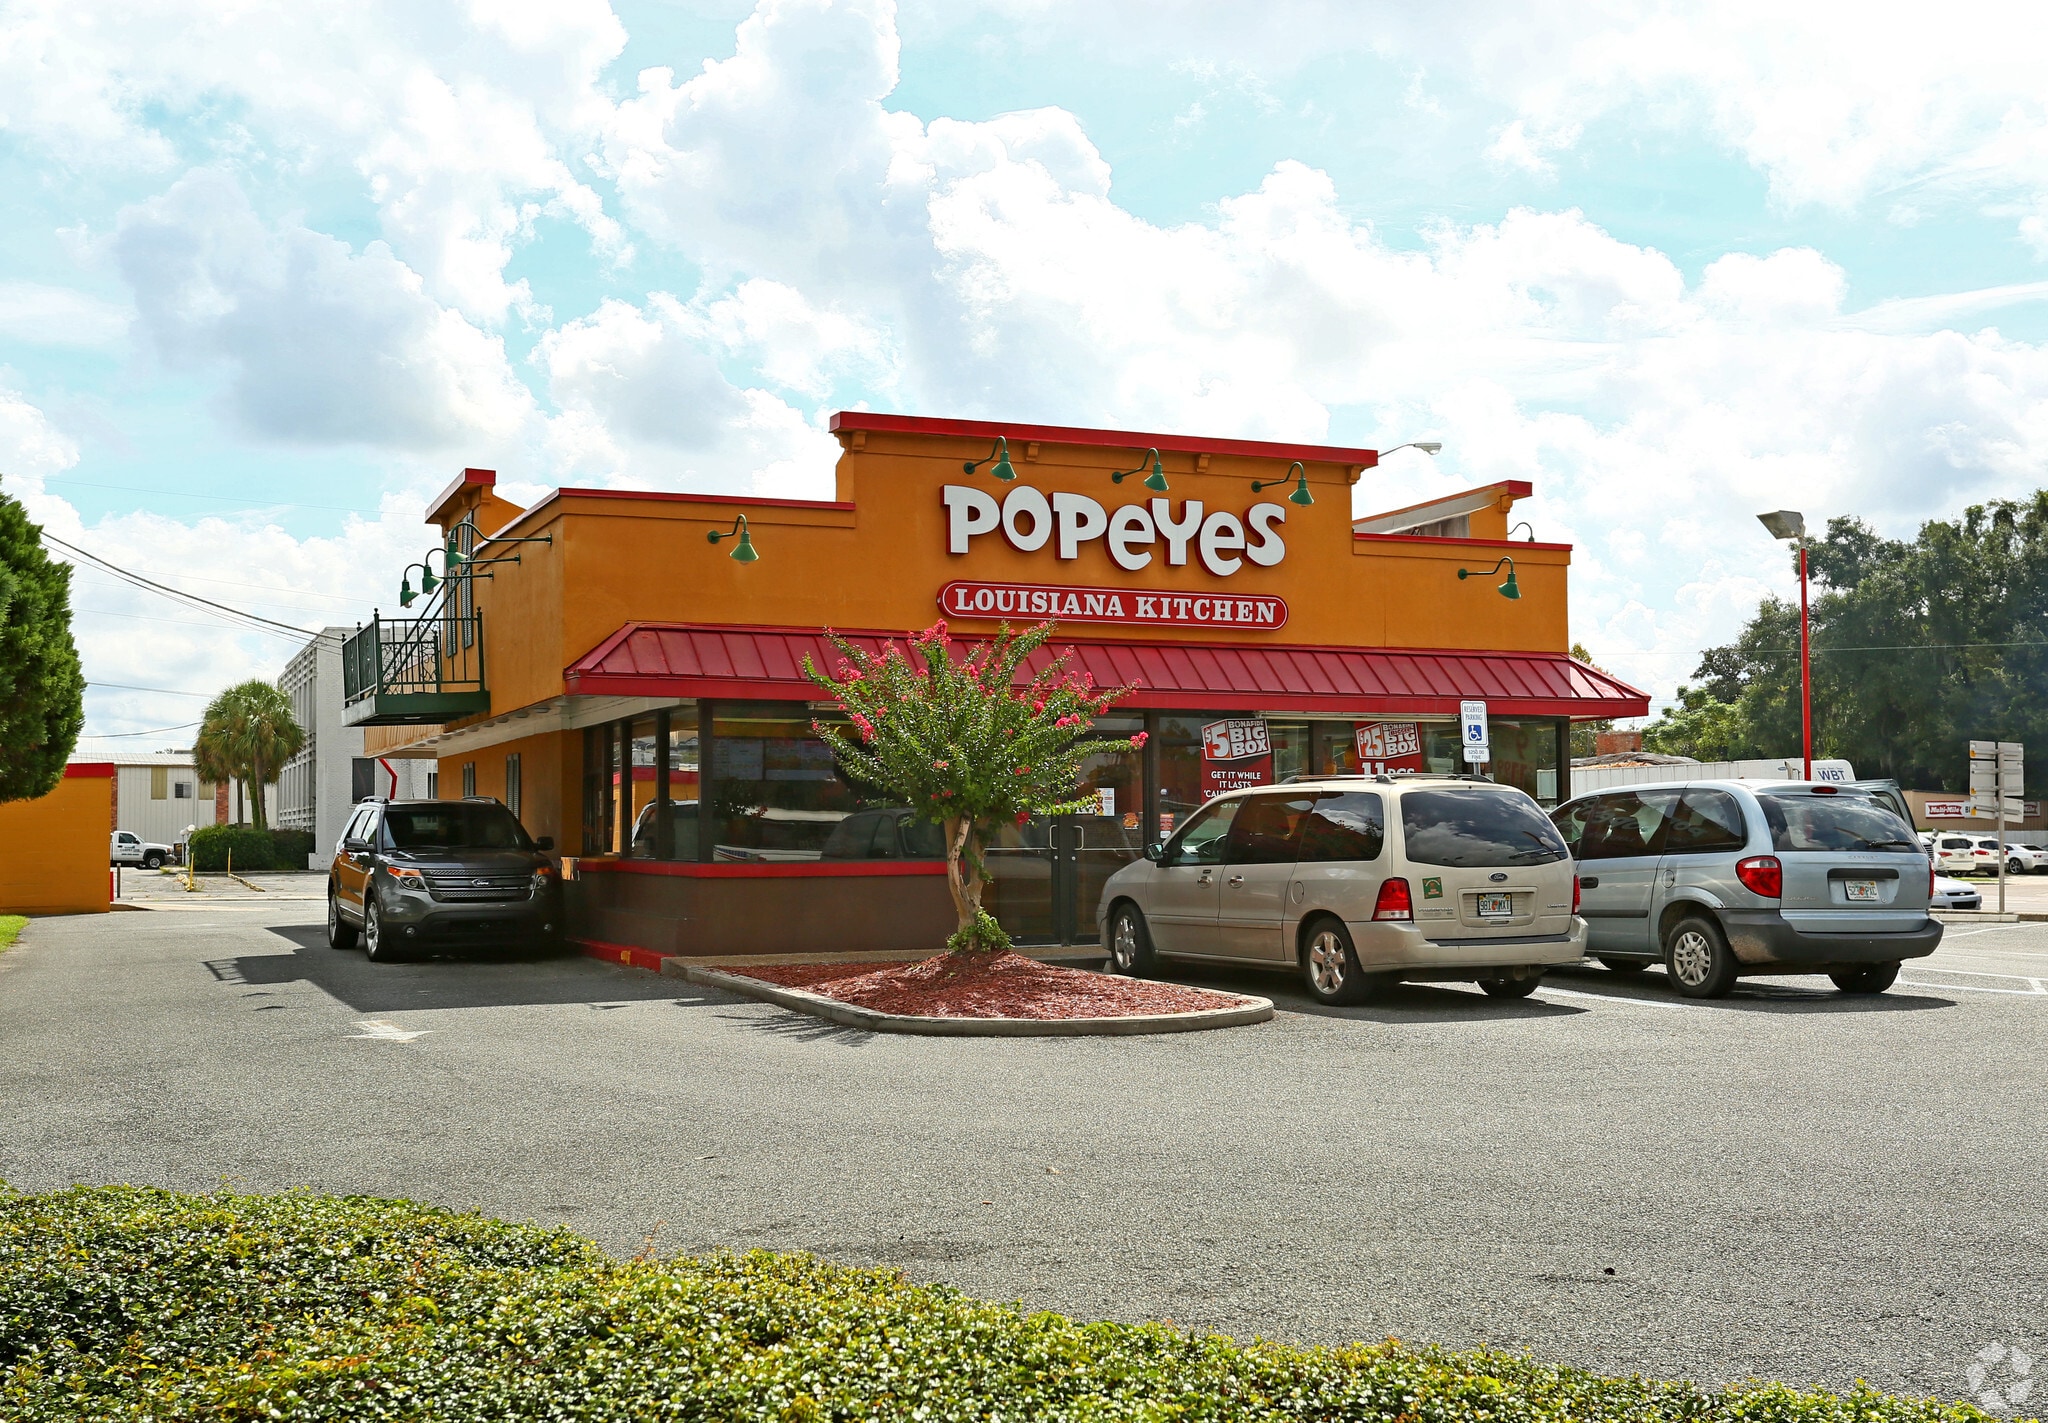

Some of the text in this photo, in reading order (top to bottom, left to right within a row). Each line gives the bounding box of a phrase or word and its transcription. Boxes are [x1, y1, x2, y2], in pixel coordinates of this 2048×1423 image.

[954, 587, 1277, 624] LOUISIANA KITCHEN
[1463, 705, 1484, 713] RESERVED
[1465, 713, 1483, 721] PARKING
[1227, 720, 1264, 729] BONAFIDE
[1204, 722, 1229, 757] $5
[1229, 726, 1266, 742] BIG
[1231, 739, 1268, 757] BOX
[1359, 727, 1384, 757] $25
[1385, 740, 1417, 756] BOX
[1211, 771, 1261, 780] GET IT WHILE
[1817, 770, 1846, 781] WBT
[1219, 781, 1252, 789] IT LASTS
